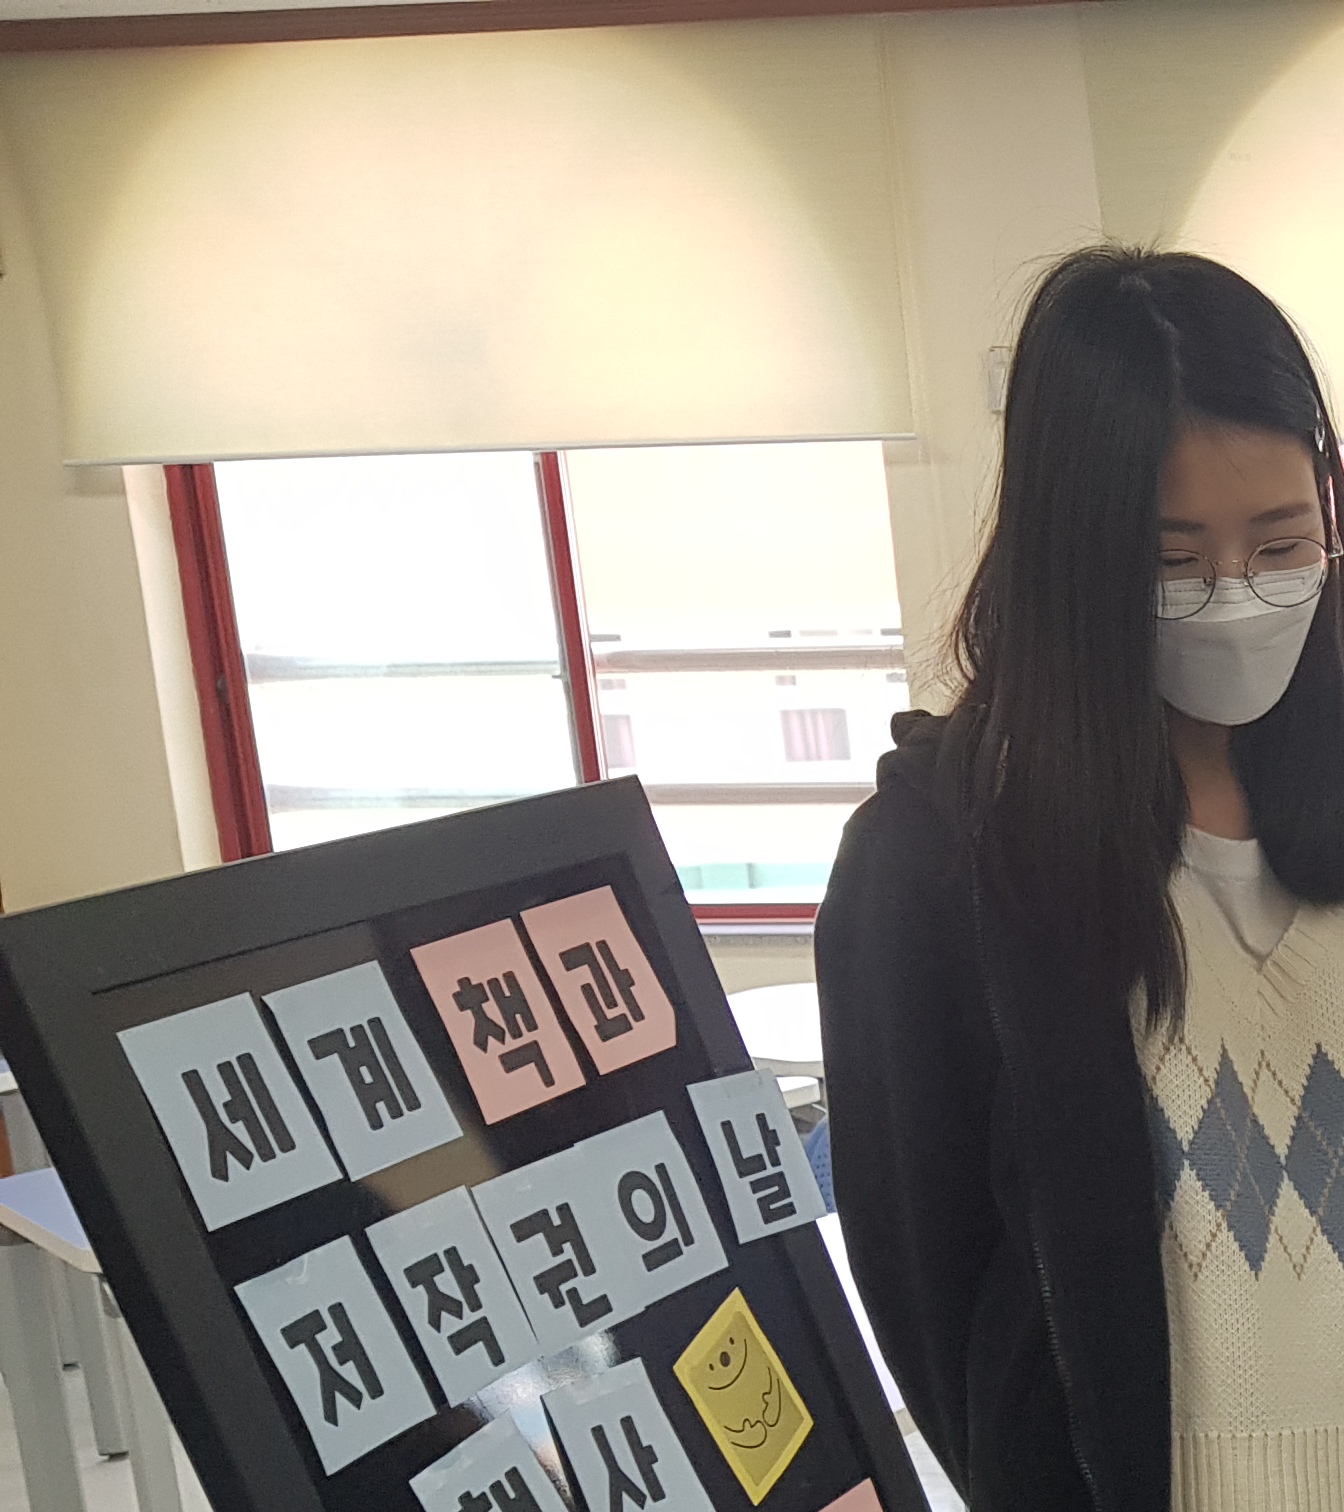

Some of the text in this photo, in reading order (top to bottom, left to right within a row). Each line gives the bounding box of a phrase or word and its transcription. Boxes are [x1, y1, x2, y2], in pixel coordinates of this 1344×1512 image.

[181, 938, 645, 1183] 세계 책과
[280, 1111, 796, 1427] 저작권의 날
